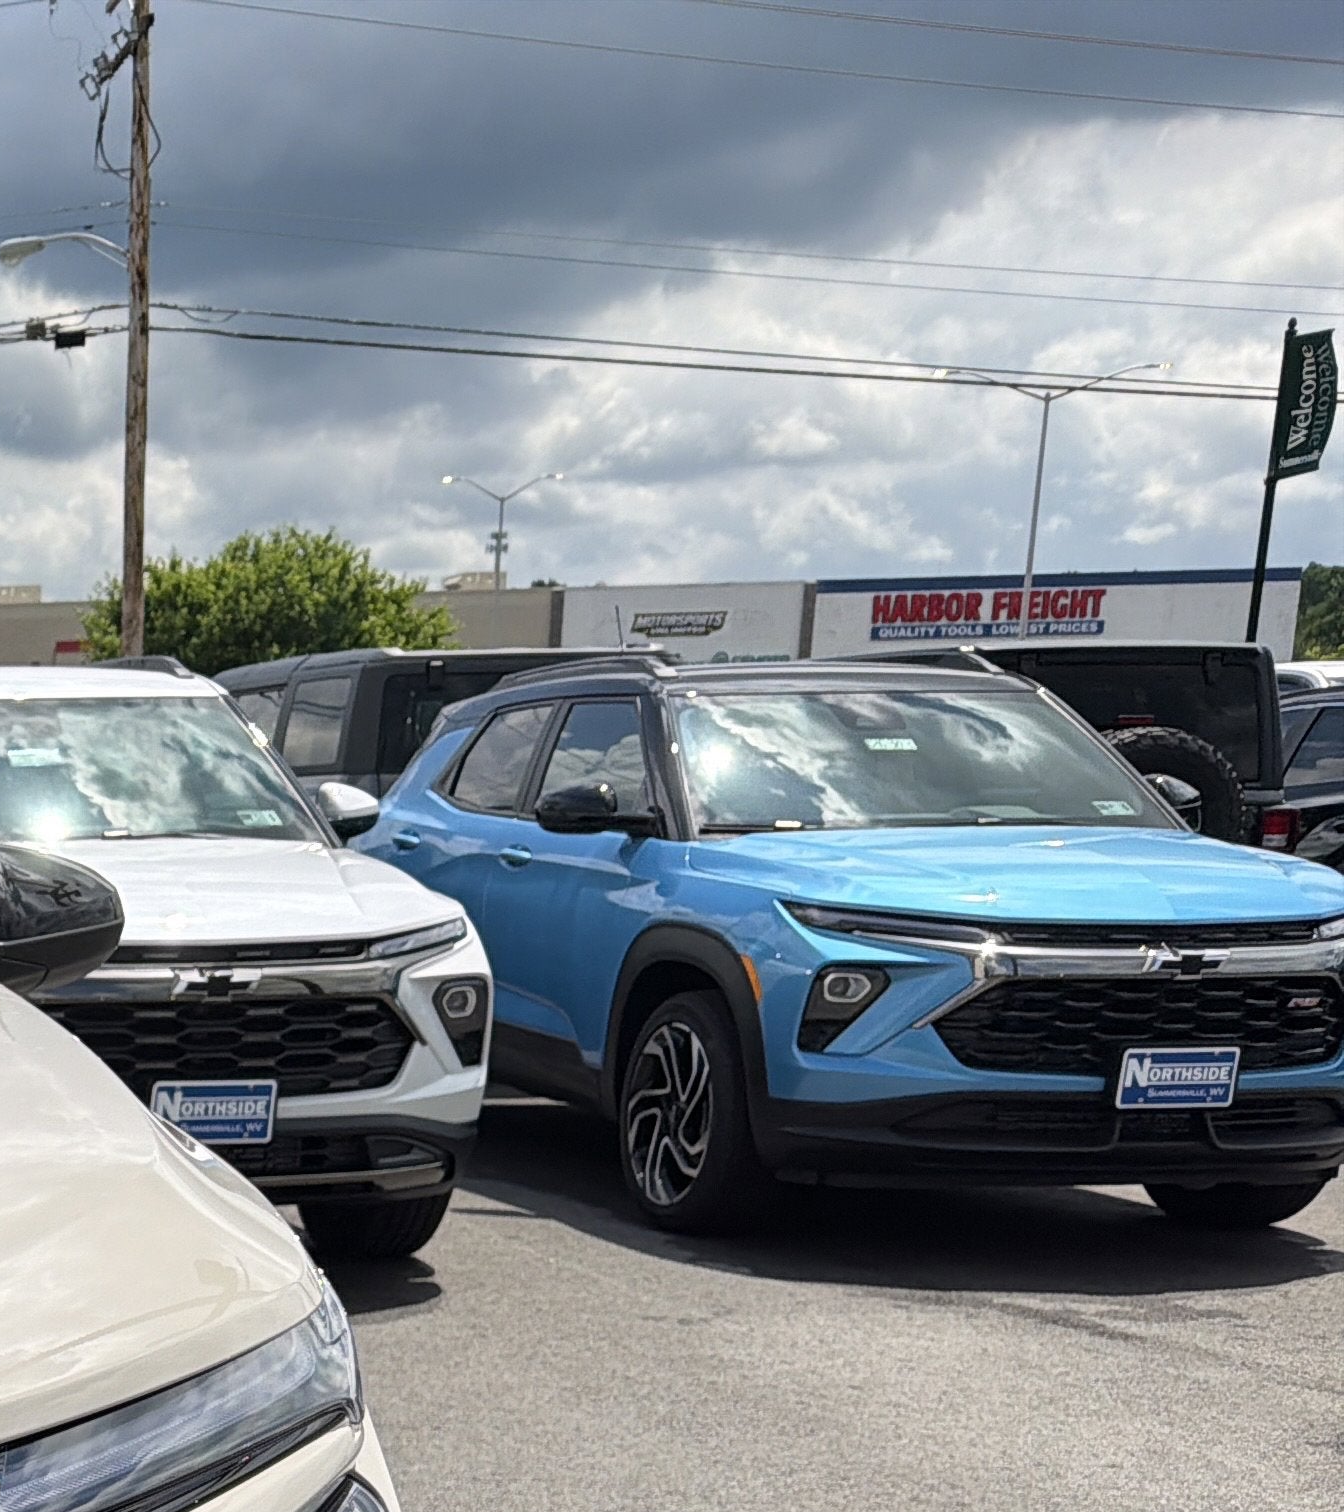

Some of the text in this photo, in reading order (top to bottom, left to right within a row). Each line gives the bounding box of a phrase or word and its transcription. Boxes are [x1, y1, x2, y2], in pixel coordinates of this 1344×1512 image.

[1287, 344, 1317, 450] Welcome
[871, 589, 1107, 624] HARBOR FREIGHT
[878, 621, 1099, 638] QUALITY TOOLS LOWST PRICES
[1124, 1057, 1231, 1088] NORTHSIDE
[156, 1090, 268, 1122] NORTHSIDE
